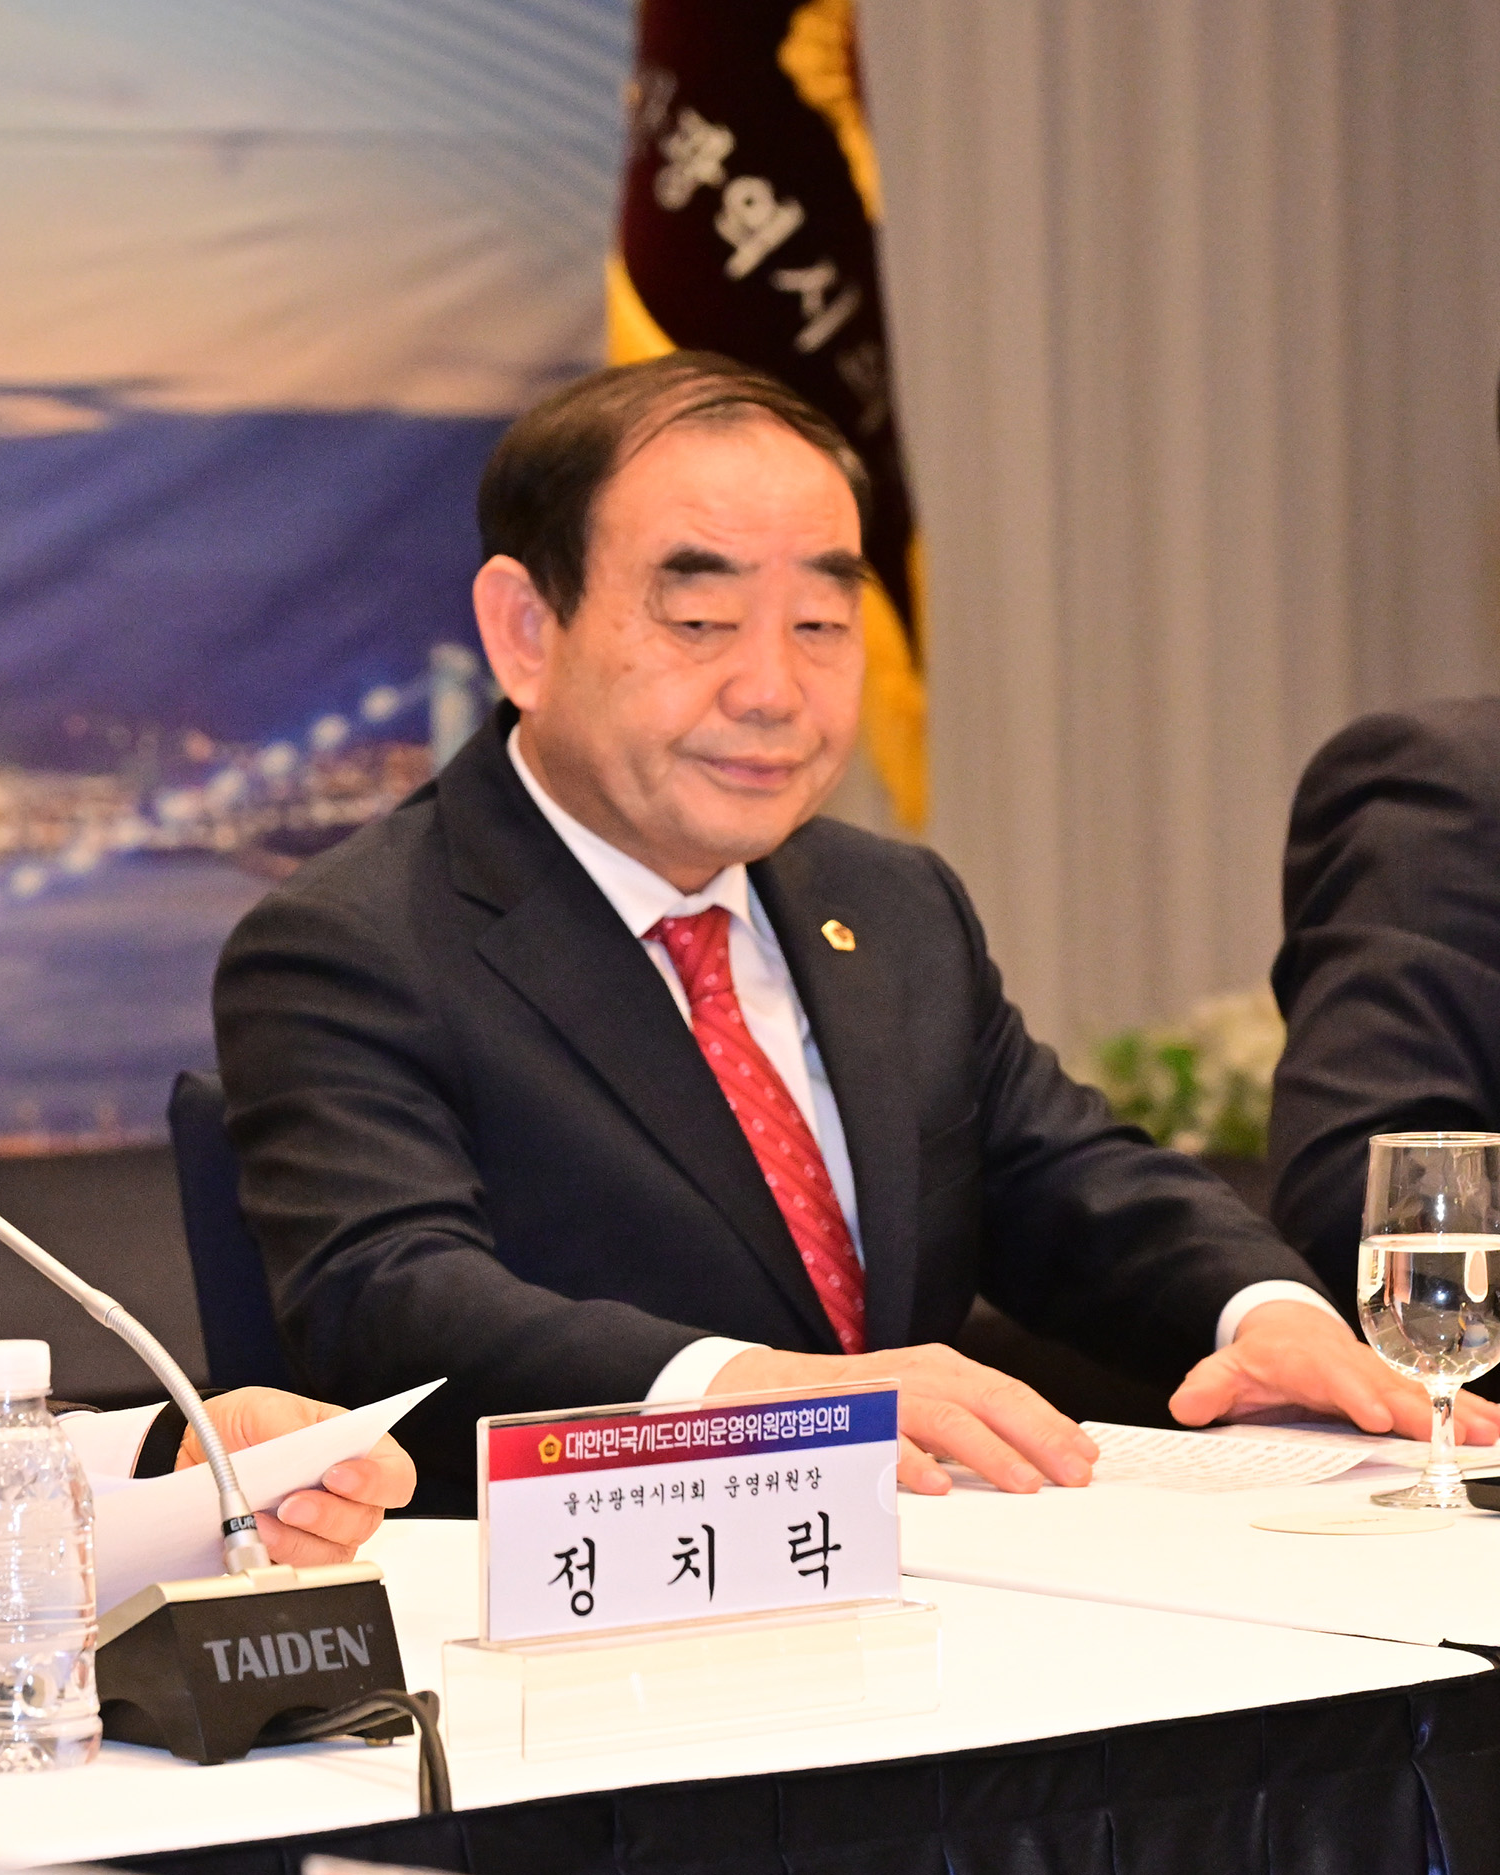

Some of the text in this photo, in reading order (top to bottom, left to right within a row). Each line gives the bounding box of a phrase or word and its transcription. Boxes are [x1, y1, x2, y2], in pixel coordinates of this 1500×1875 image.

[565, 1405, 850, 1460] 대한민국시도의회운영위원장협의회
[563, 1466, 822, 1516] 울산광역시의회 운영위원장
[203, 1624, 371, 1683] TAIDEN
